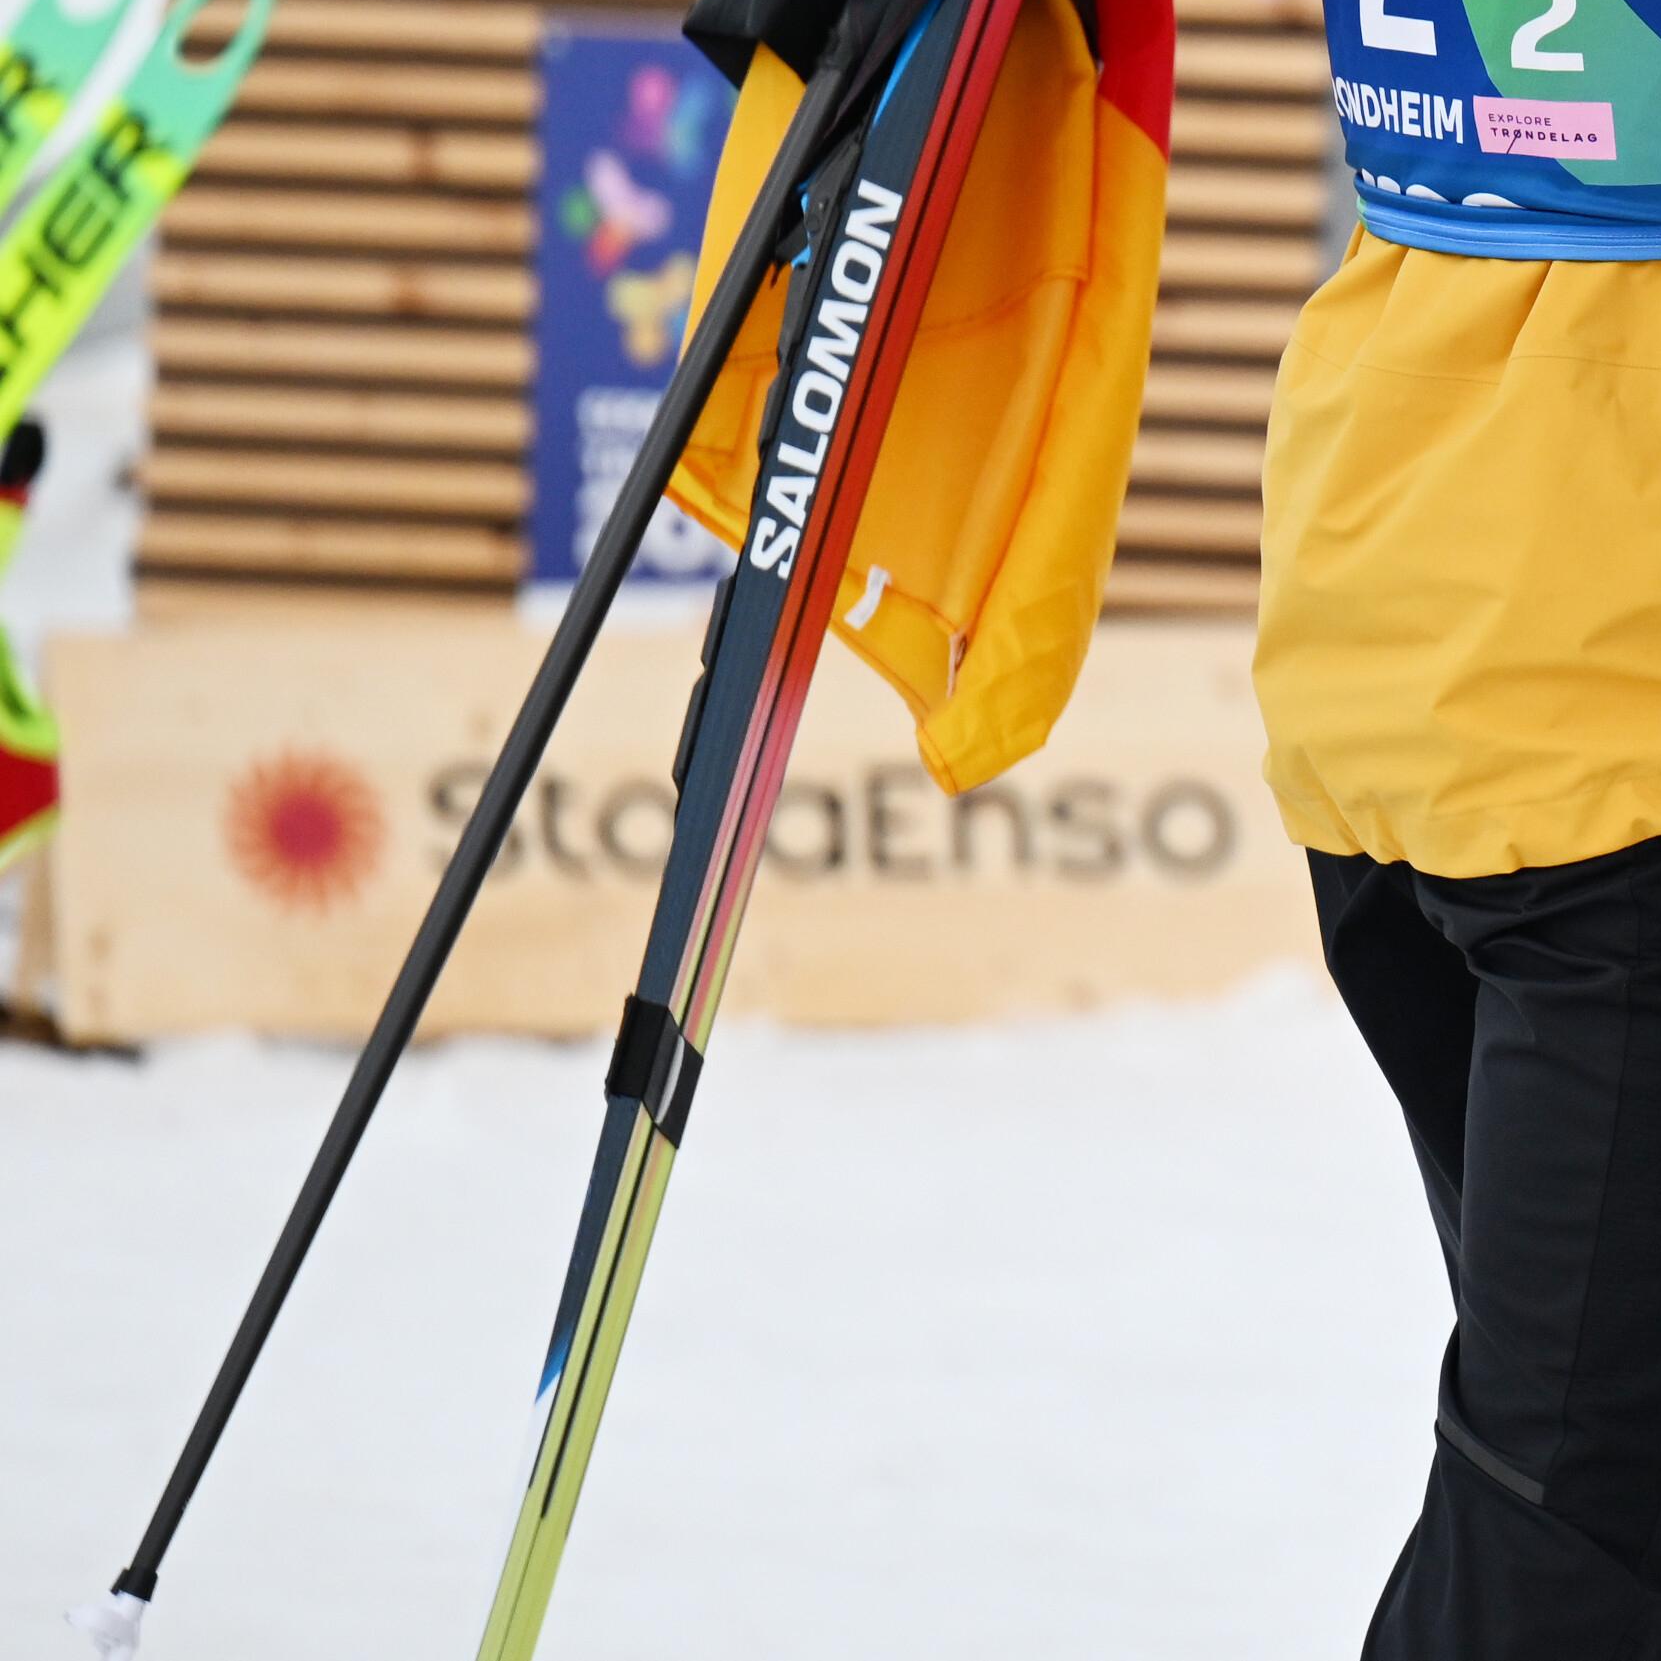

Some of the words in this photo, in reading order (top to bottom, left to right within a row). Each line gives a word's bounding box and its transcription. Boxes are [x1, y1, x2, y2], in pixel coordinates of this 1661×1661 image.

[1332, 77, 1464, 145] ONDHEIM
[1488, 113, 1553, 127] EXPLORE
[1489, 127, 1599, 144] TRØNDELAG
[748, 178, 904, 581] SALOMON
[425, 755, 1238, 880] StoaEnso
